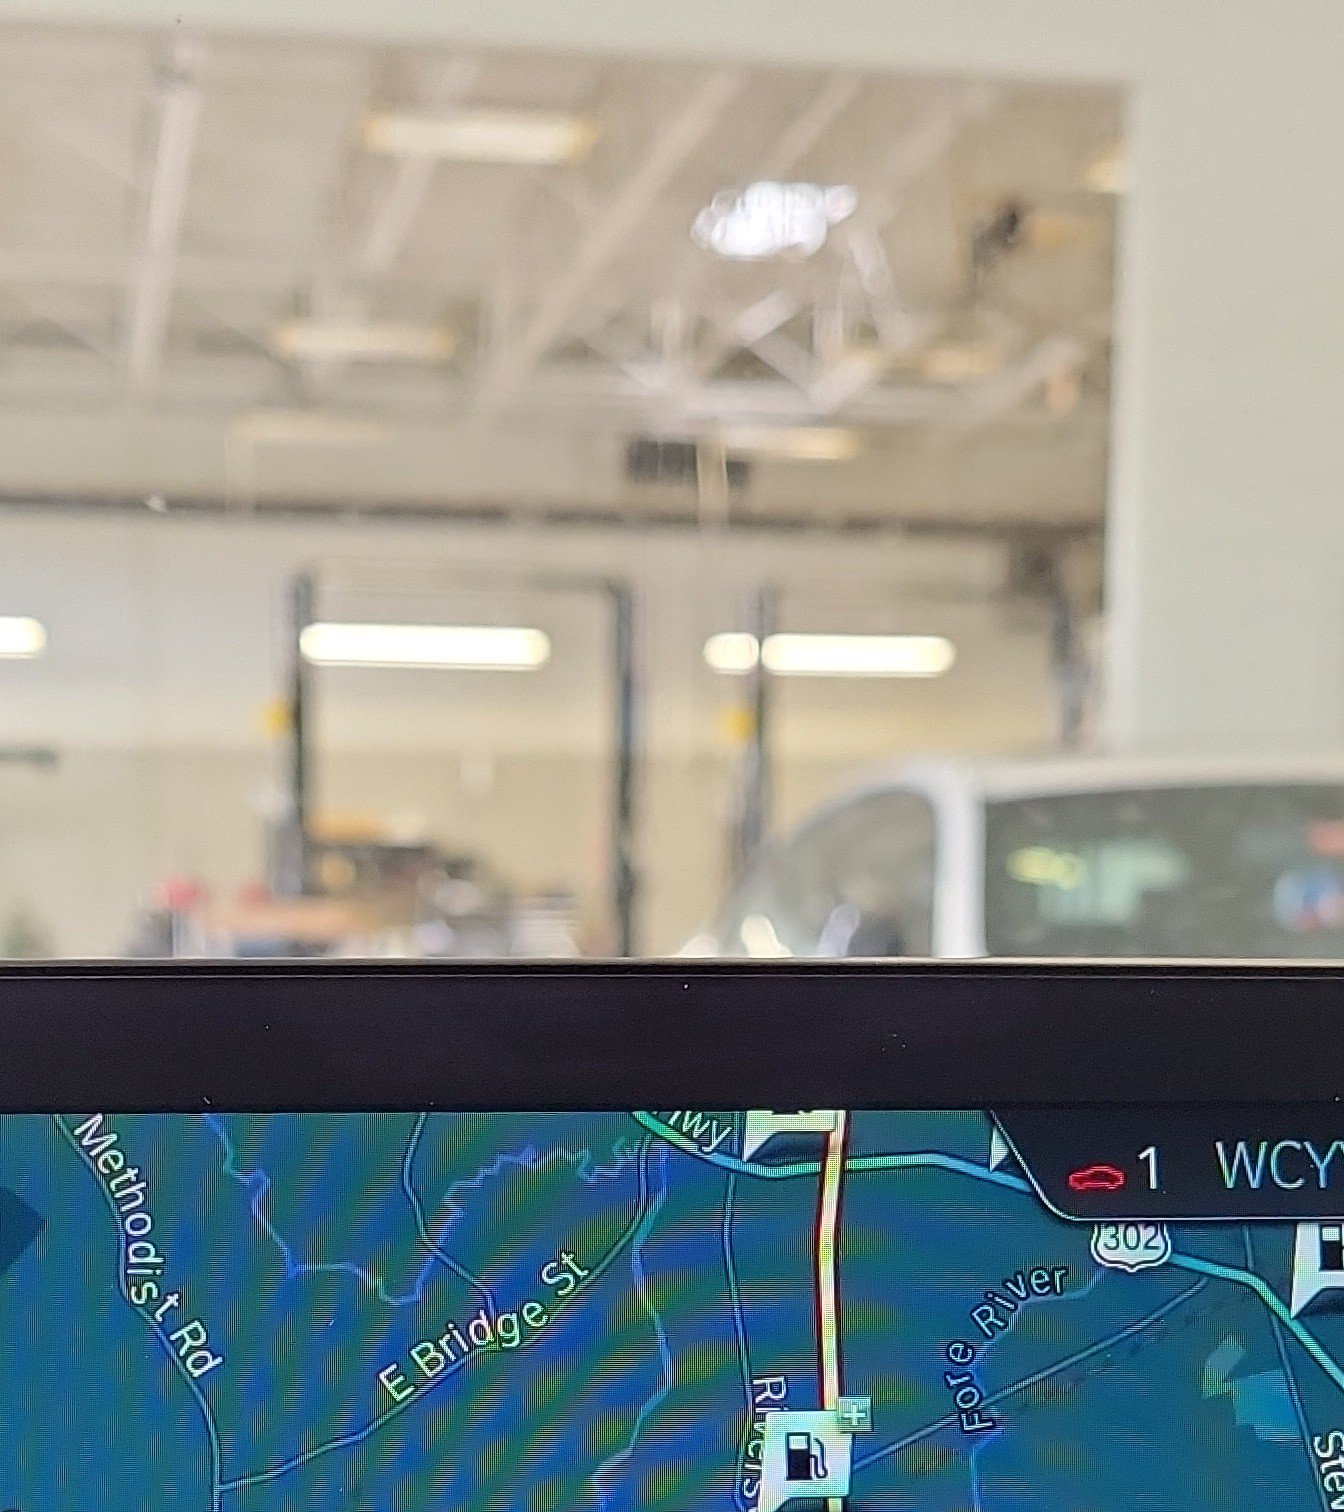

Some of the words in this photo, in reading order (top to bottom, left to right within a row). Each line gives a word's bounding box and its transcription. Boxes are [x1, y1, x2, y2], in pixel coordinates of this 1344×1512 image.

[654, 1110, 733, 1152] wy
[1136, 1147, 1159, 1190] 1
[74, 1113, 182, 1318] Methodist
[167, 1320, 225, 1379] Rd
[1102, 1222, 1160, 1250] 302
[377, 1364, 413, 1403] E
[409, 1302, 550, 1382] Bridge
[540, 1249, 590, 1297] St
[971, 1264, 1069, 1338] River
[945, 1340, 1003, 1434] Fore
